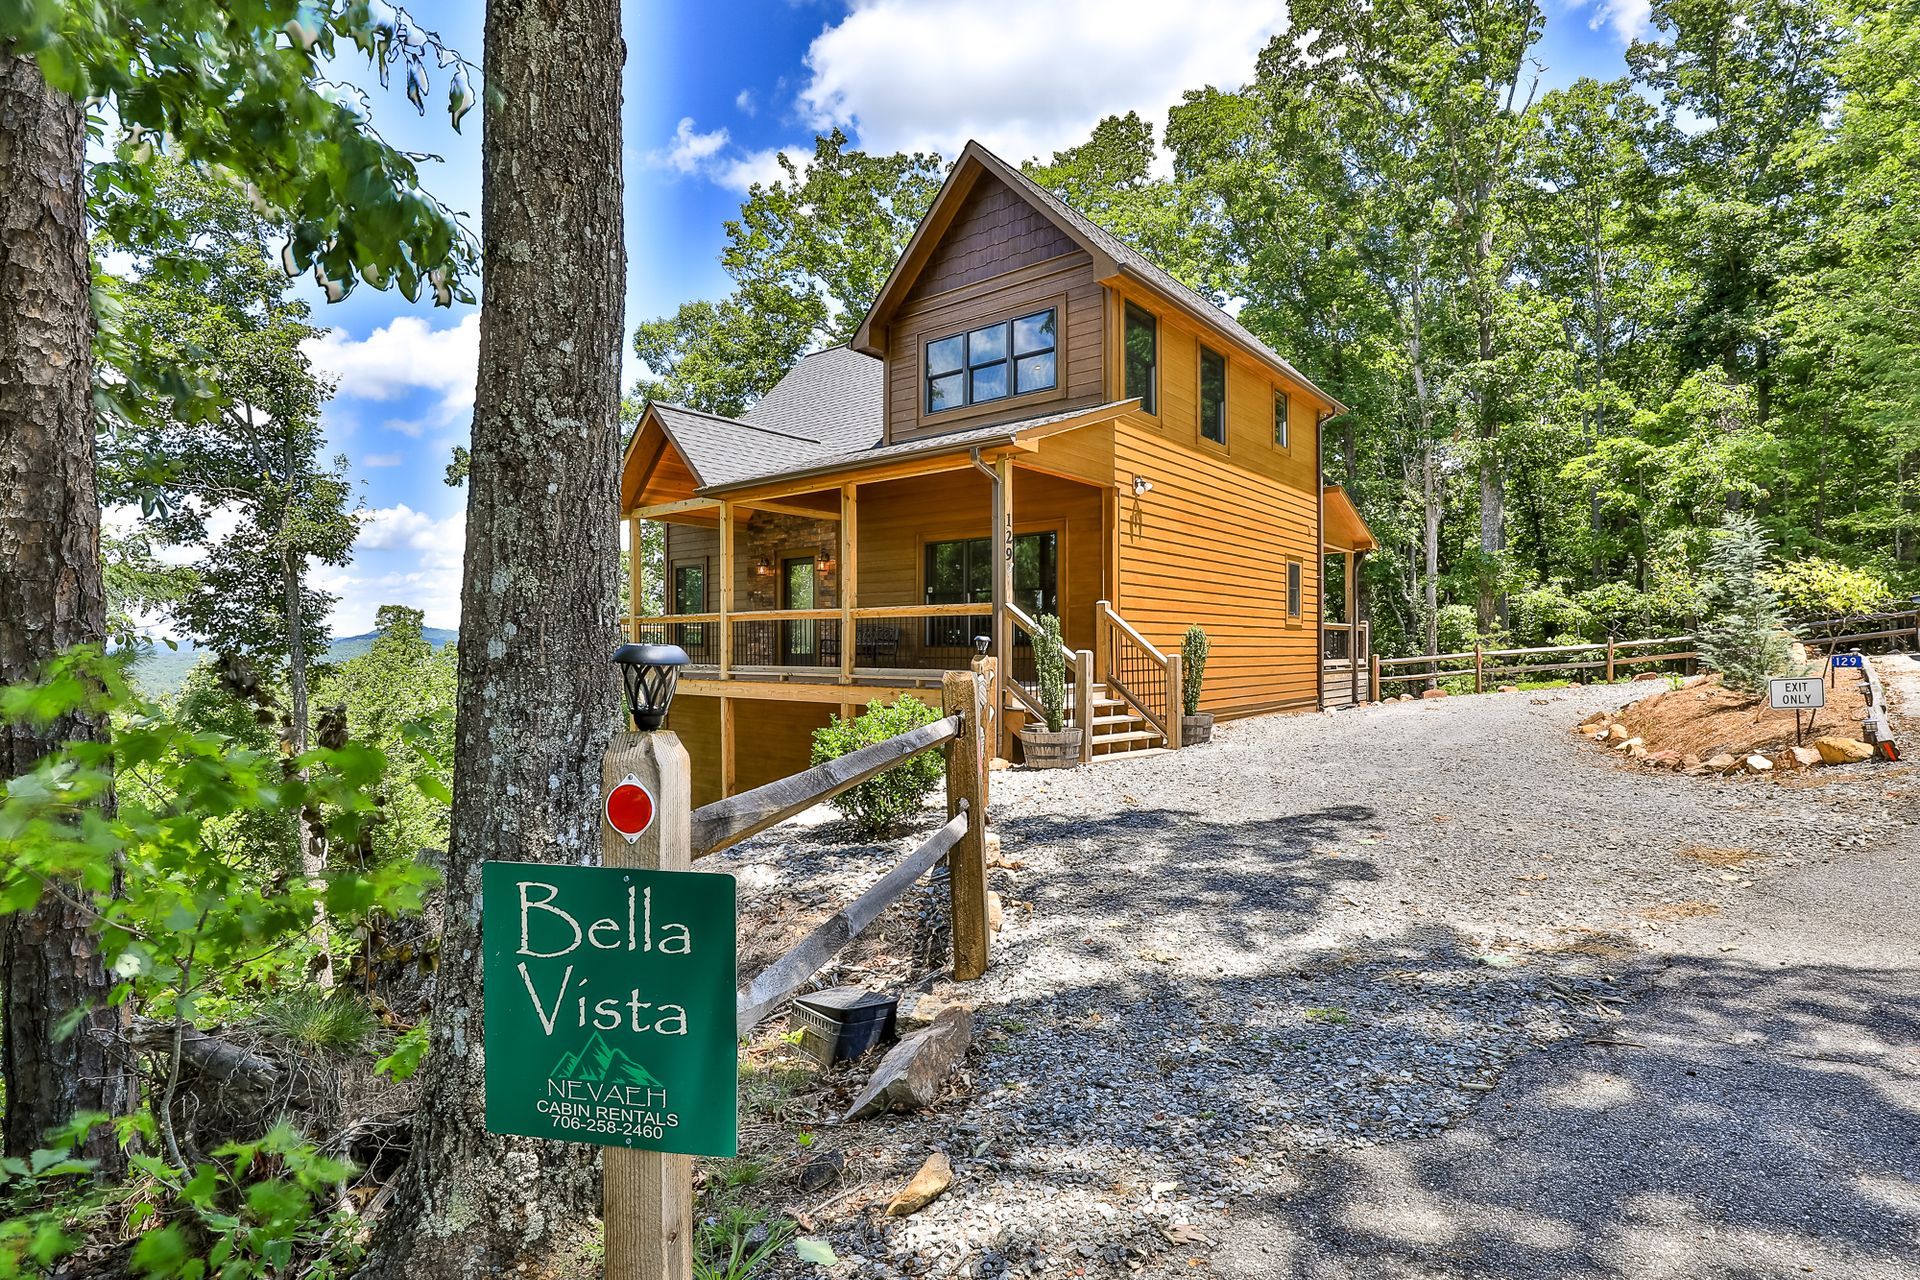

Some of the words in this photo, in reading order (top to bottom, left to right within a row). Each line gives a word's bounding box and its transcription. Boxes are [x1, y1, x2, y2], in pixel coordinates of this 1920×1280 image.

[1835, 657, 1857, 666] 129
[1782, 694, 1812, 705] ONLY
[1785, 682, 1808, 693] EXIT
[516, 881, 692, 958] Bella
[517, 962, 688, 1036] Vista
[548, 1078, 666, 1108] NEVAEH
[536, 1100, 590, 1118] CABIN
[596, 1106, 679, 1127] RENTALS
[551, 1115, 663, 1139] 706-258-2460
